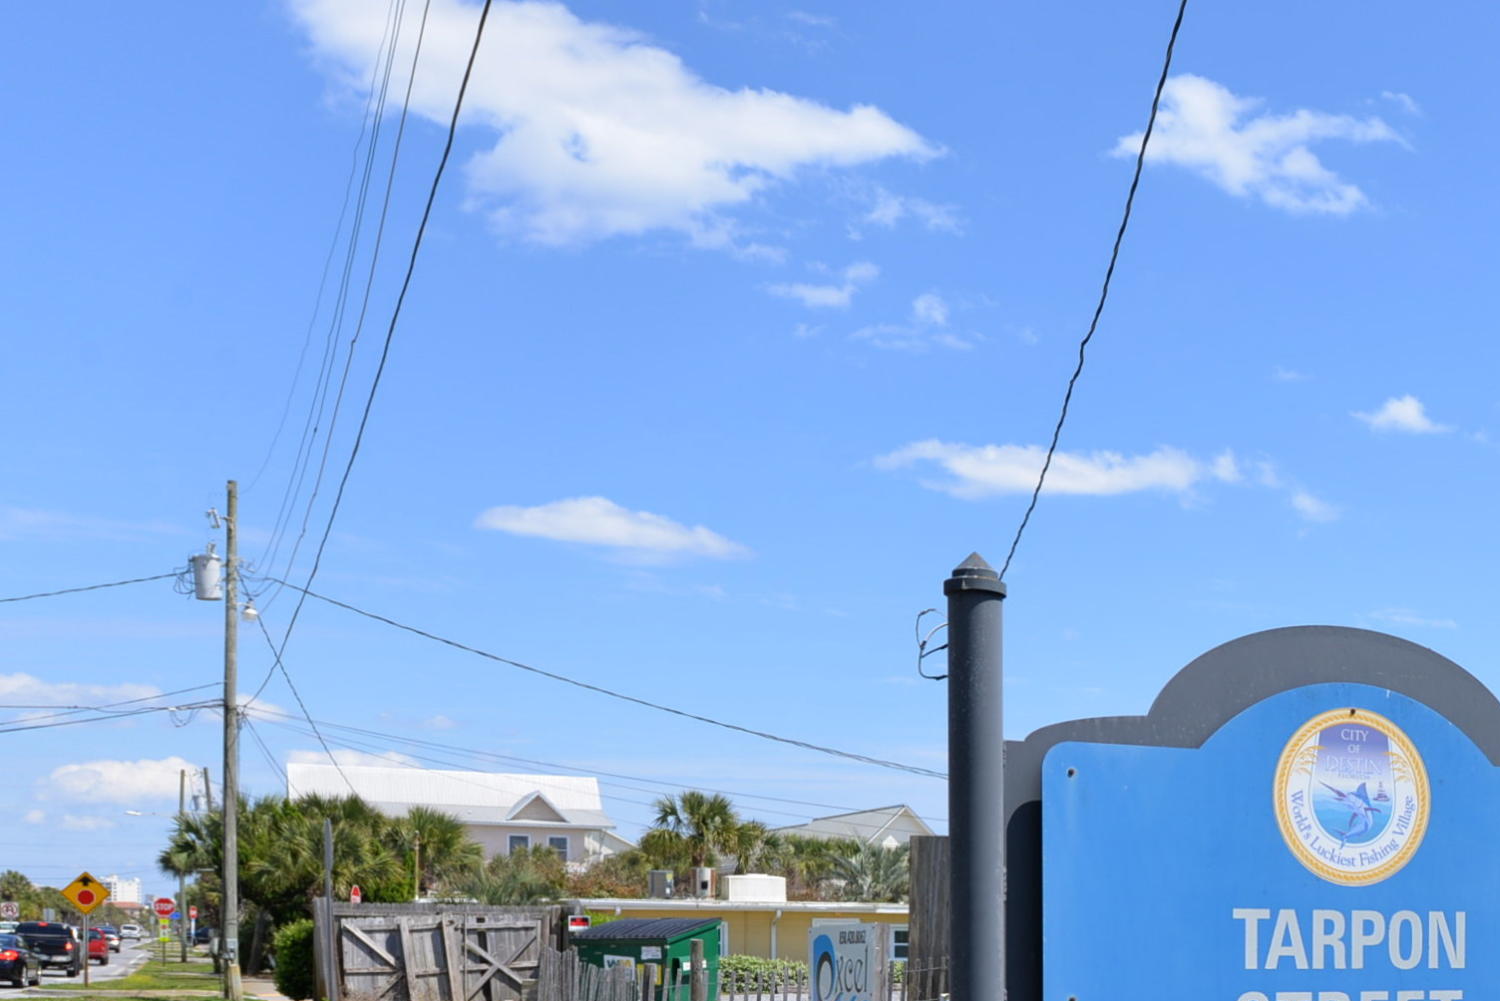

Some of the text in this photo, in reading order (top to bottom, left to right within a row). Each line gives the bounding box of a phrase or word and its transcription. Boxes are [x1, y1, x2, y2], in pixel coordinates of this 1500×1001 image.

[1341, 729, 1369, 742] CITY
[1326, 755, 1384, 775] DESTIN
[1291, 789, 1416, 868] World's Luckiest Fishing Village
[1233, 907, 1467, 970] TARPON
